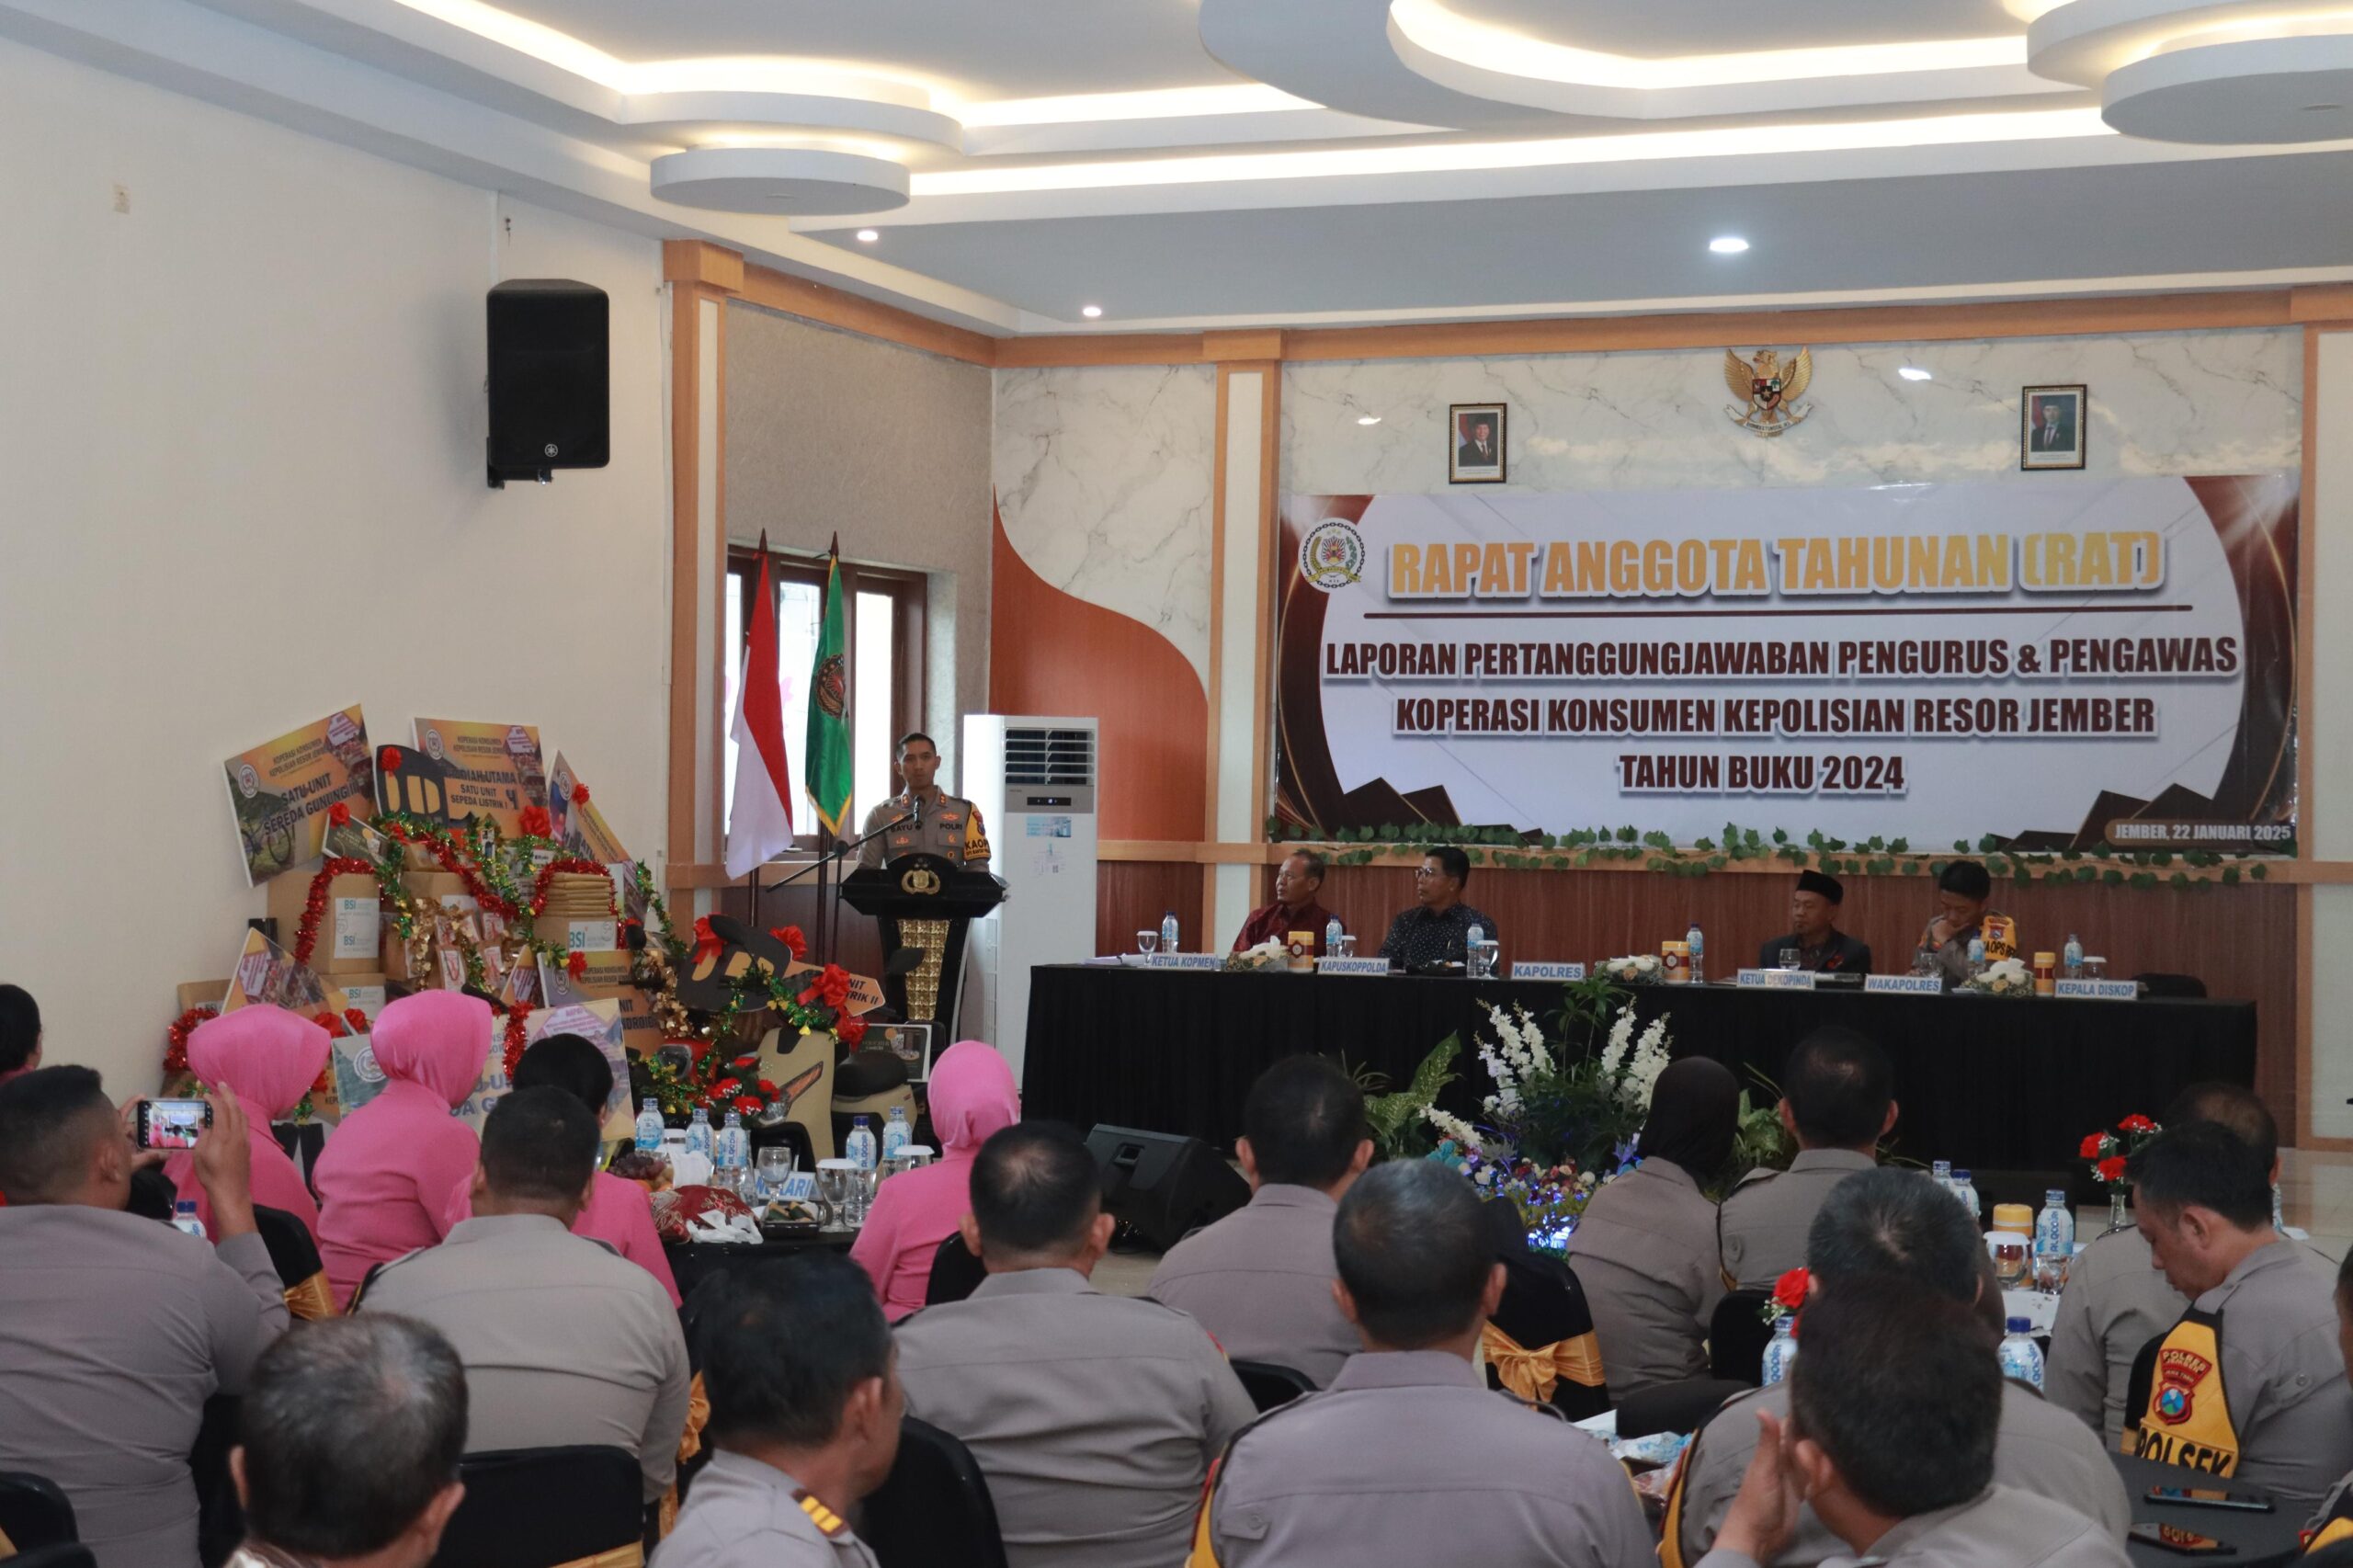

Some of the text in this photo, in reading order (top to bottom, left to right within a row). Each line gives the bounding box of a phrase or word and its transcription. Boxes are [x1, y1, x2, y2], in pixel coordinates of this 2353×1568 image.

[1391, 530, 2164, 596] RAPAT ANGGOTA TAHUNAN (RAT)
[1325, 636, 2239, 676] LAPORAN PERTANGGUNGJAWABAN PENGURUS & PENGAWAS
[1396, 698, 2155, 733] KOPERASI KONSUMEN KEPOLISIAN RESOR JEMBER
[1620, 755, 1905, 790] TAHUN BUKU 2024
[281, 773, 331, 806] SATU UNIT
[460, 784, 496, 797] SATU UNIT
[450, 794, 477, 807] SEPEDA
[479, 798, 503, 809] LISTRIK
[264, 805, 305, 835] SEPEDA
[305, 786, 347, 816] GUNUNG
[939, 823, 962, 831] POLRI
[2114, 824, 2291, 840] JEMBER, 22 JANUARI 2025
[569, 931, 585, 949] BSI
[1990, 940, 2006, 956] OPS
[1152, 957, 1216, 968] KETUA KOPMEN
[1321, 961, 1386, 972] KAPUSKOPPOLDA
[1514, 965, 1582, 978] KAPOLRES
[1739, 973, 1765, 985] KETUA
[848, 979, 867, 991] NIT
[1867, 977, 1939, 992] WAKAPOLRES
[2058, 983, 2135, 996] KEPALA DISKOP
[846, 991, 869, 1003] TRIK
[620, 999, 633, 1013] NIT
[1770, 1344, 1781, 1382] QODIRI
[2135, 1427, 2233, 1477] POLSEK
